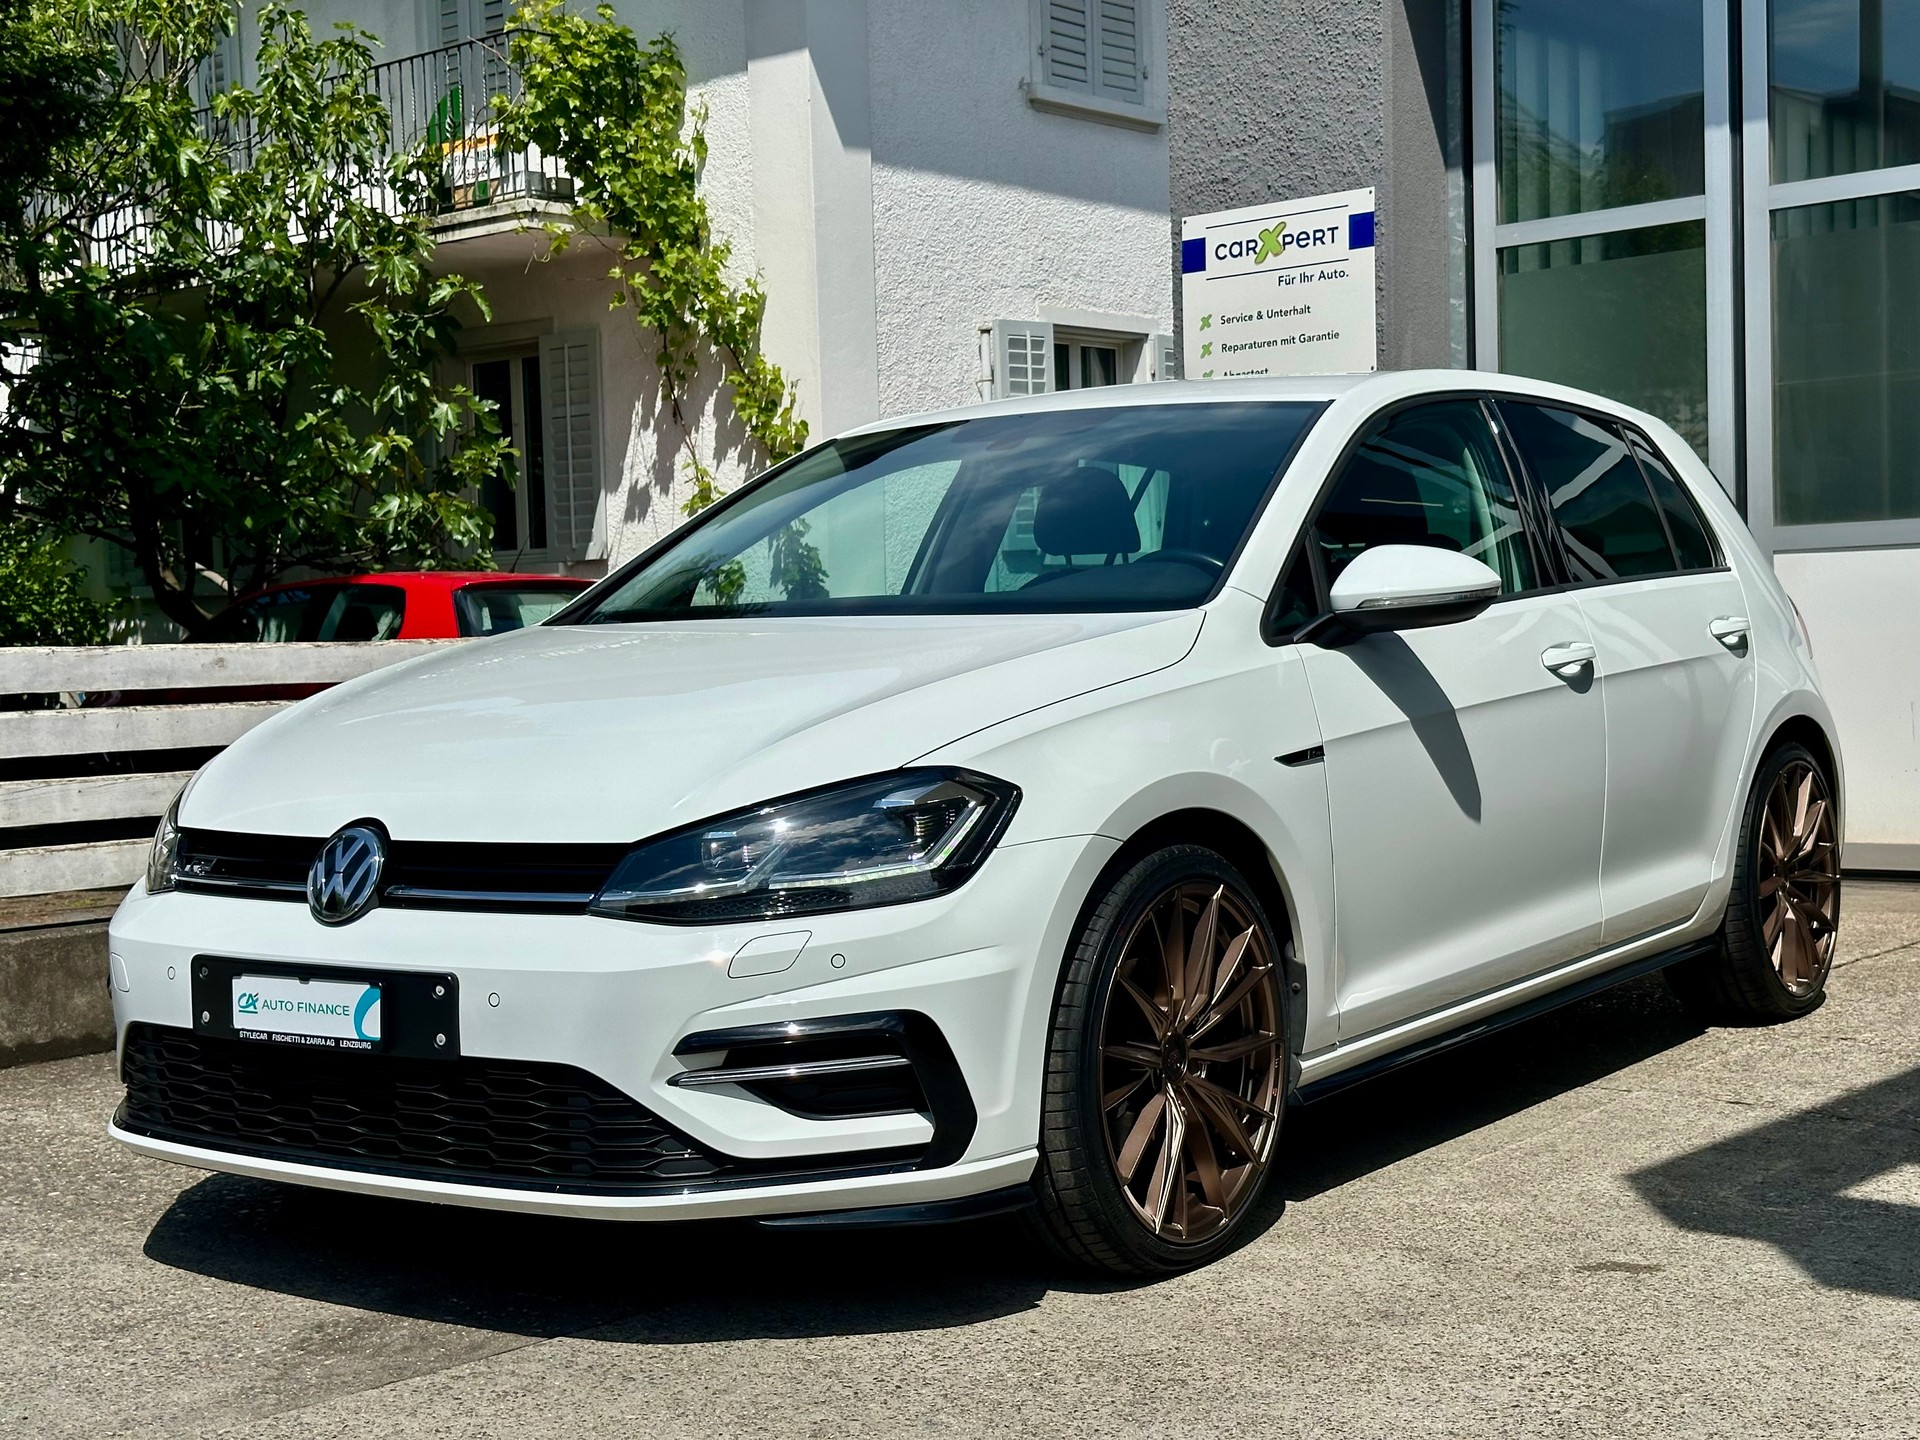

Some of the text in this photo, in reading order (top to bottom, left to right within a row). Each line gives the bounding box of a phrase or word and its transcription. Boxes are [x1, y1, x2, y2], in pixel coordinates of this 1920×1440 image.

[1278, 268, 1349, 286] Für Ihr Auto.
[1220, 304, 1311, 325] Service & Unterhalt
[1221, 330, 1340, 354] Reparaturen mit Garantie
[261, 999, 294, 1012] AUTO
[297, 1001, 350, 1017] FINANCE
[239, 1030, 268, 1041] STYLECAR
[272, 1033, 301, 1044] FISCHETTI
[306, 1036, 326, 1046] ZARRA
[339, 1040, 372, 1050] LENZBURG
